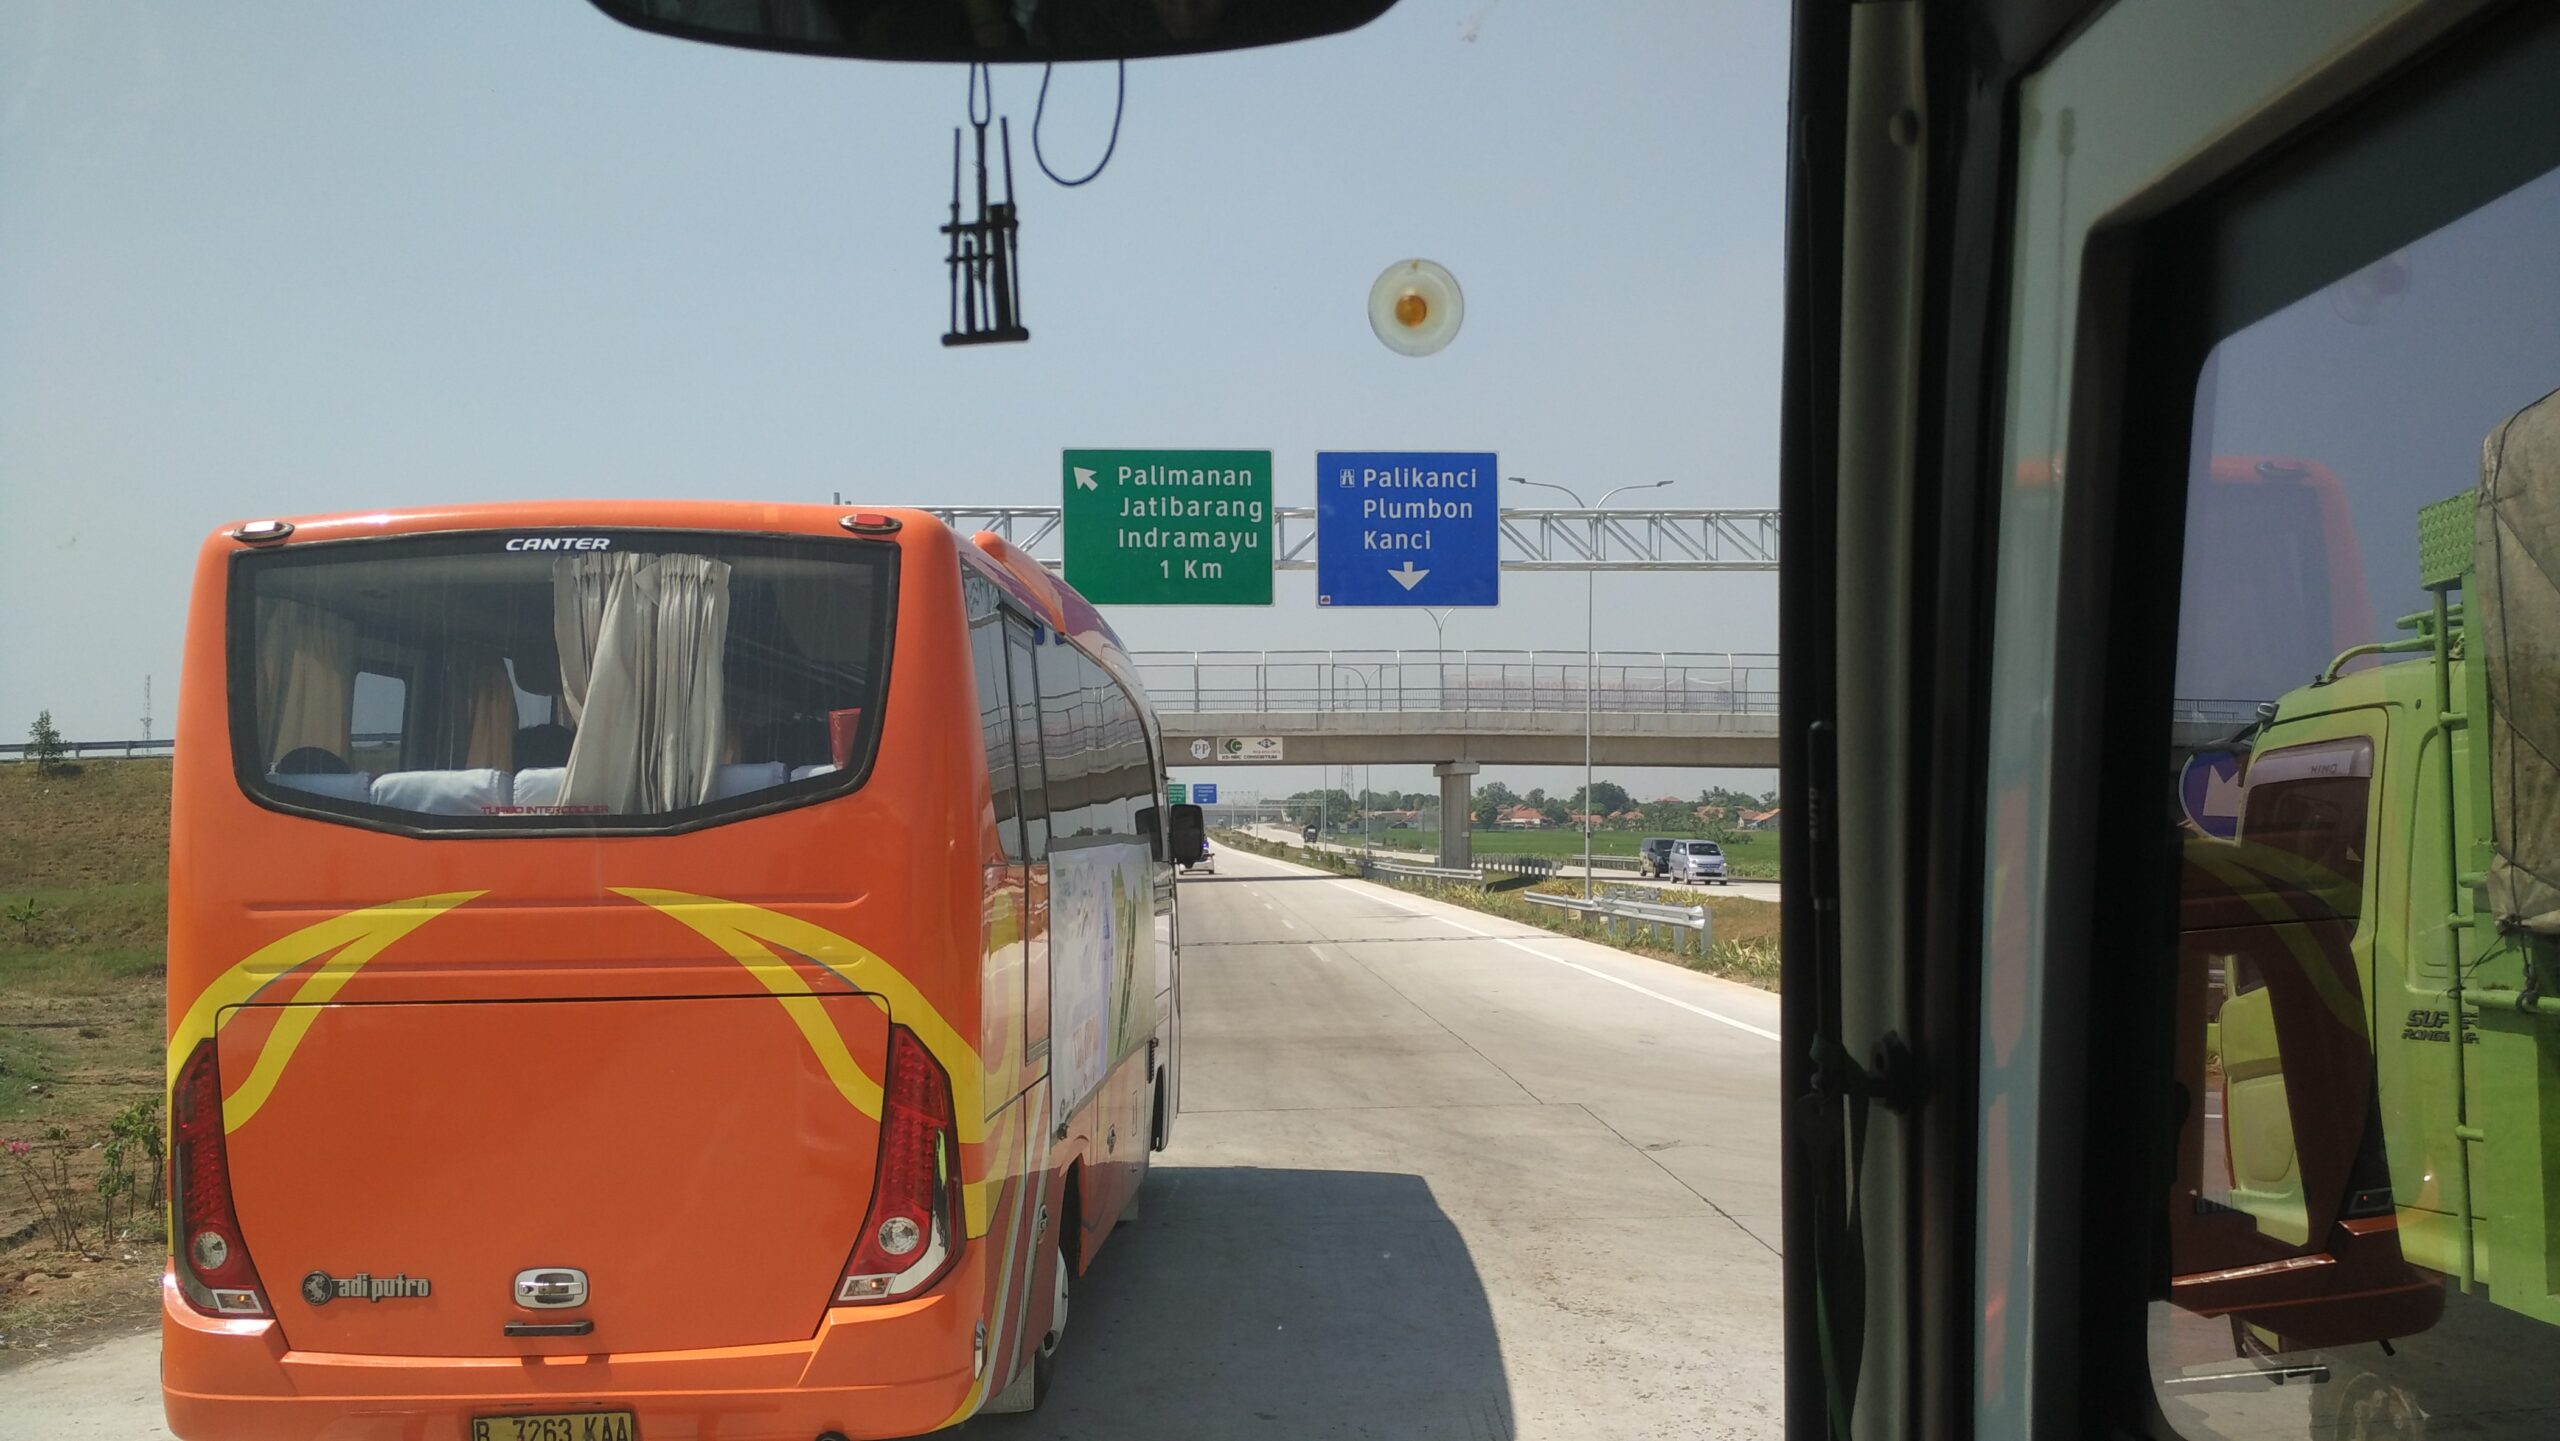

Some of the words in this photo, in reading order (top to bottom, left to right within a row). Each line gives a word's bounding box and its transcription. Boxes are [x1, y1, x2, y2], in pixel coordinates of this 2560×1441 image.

[1118, 465, 1252, 486] Palimanan
[1363, 467, 1477, 488] Palikanci
[1119, 496, 1263, 523] Jatibarang
[1363, 498, 1473, 519] Plumbon
[505, 538, 611, 551] CANTER
[1118, 527, 1259, 553] Indramayu
[1363, 530, 1431, 550] Kanci
[1159, 559, 1169, 579] 1
[1184, 559, 1223, 579] Km
[1194, 743, 1209, 754] PP
[338, 1273, 369, 1297] adi
[371, 1273, 430, 1302] putro
[476, 1421, 490, 1441] B
[512, 1418, 572, 1441] 7263
[584, 1416, 629, 1441] KAA
